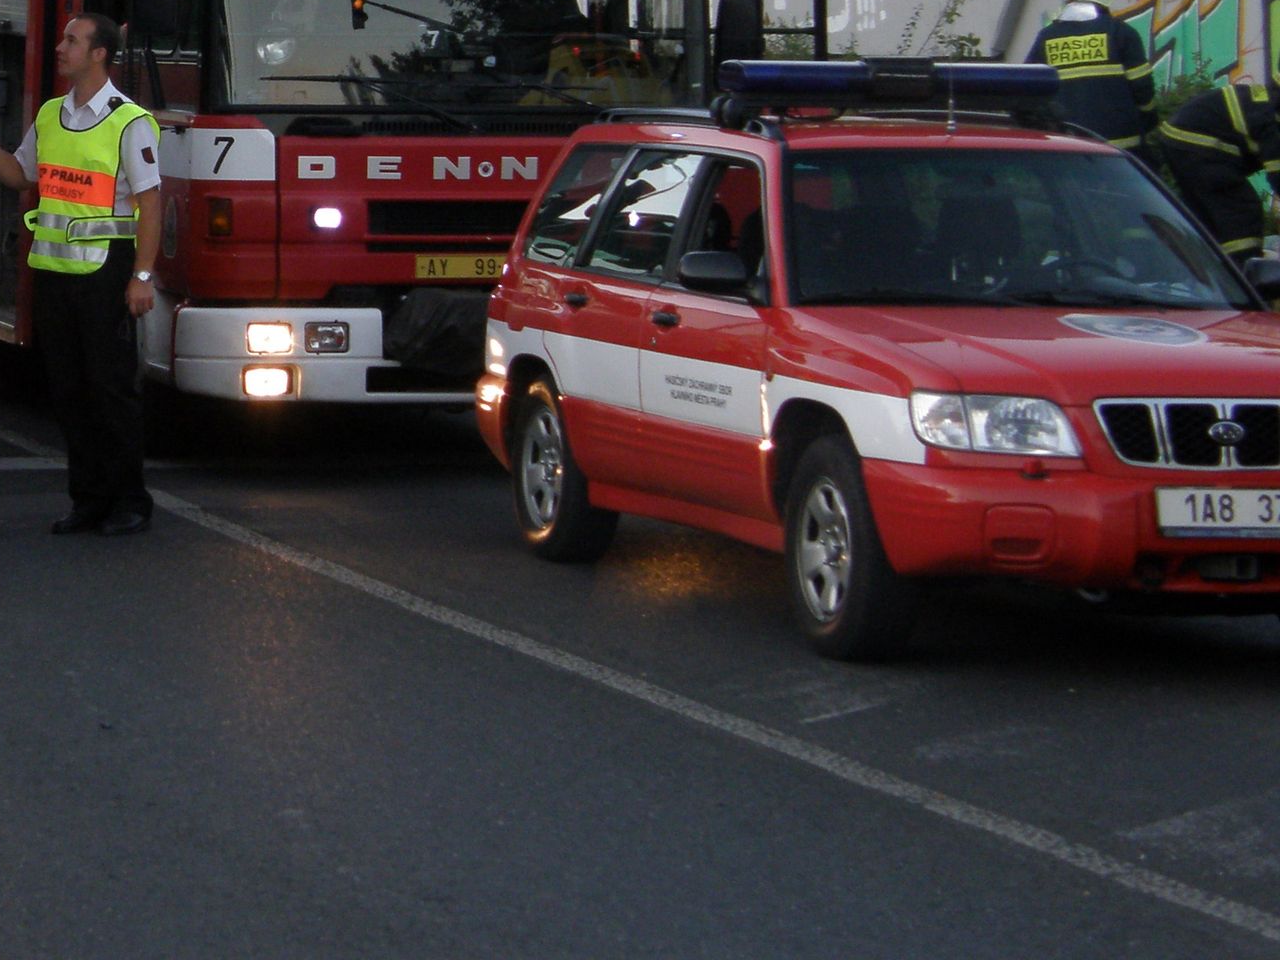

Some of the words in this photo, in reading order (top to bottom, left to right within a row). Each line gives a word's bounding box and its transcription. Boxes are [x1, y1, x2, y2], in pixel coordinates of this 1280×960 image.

[427, 30, 439, 48] 7
[1047, 37, 1104, 53] HASIČI
[1049, 49, 1104, 64] PRAHA
[212, 136, 235, 175] 7
[50, 169, 93, 186] PRAHA
[42, 183, 85, 199] TOBUSY
[427, 259, 448, 276] AY
[1185, 493, 1235, 522] 1A8
